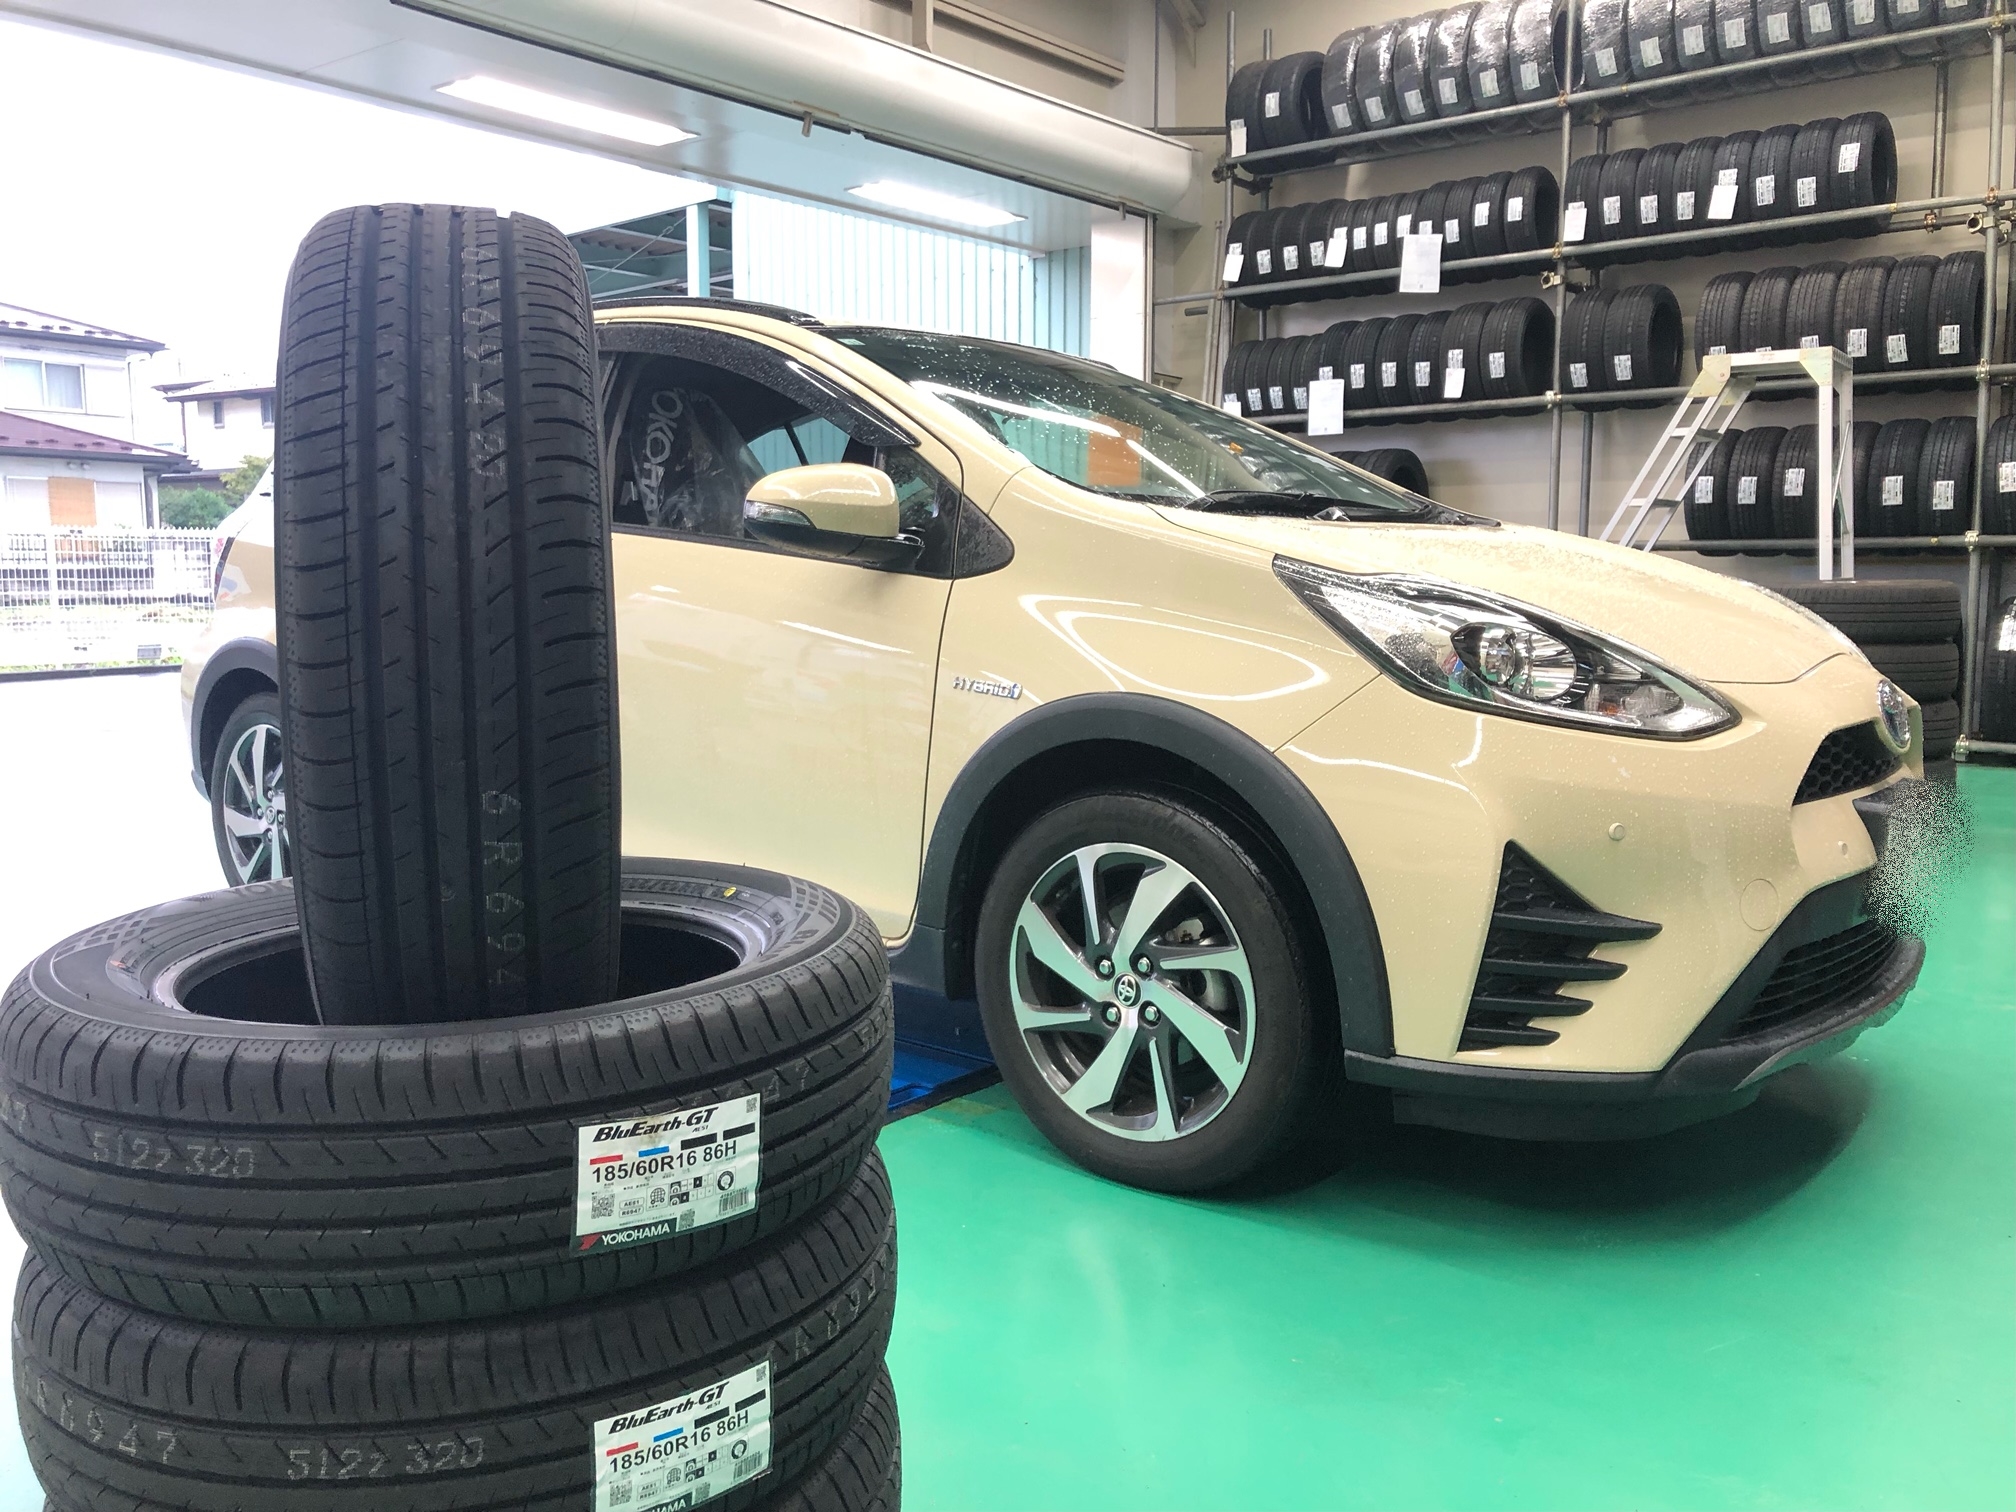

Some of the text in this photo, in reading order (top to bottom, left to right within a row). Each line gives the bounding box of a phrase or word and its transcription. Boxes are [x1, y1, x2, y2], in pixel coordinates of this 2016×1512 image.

[953, 676, 1011, 698] HYBRID
[592, 1106, 719, 1143] BluEarth-GT
[185, 1144, 256, 1179] 320
[592, 1150, 697, 1185] 185/60R16
[703, 1139, 737, 1163] 86H
[602, 1222, 670, 1246] YOKOHAMA
[608, 1381, 730, 1435] BluEarth-GT
[405, 1436, 484, 1474] 320
[609, 1409, 749, 1474] 185/60R16 86H
